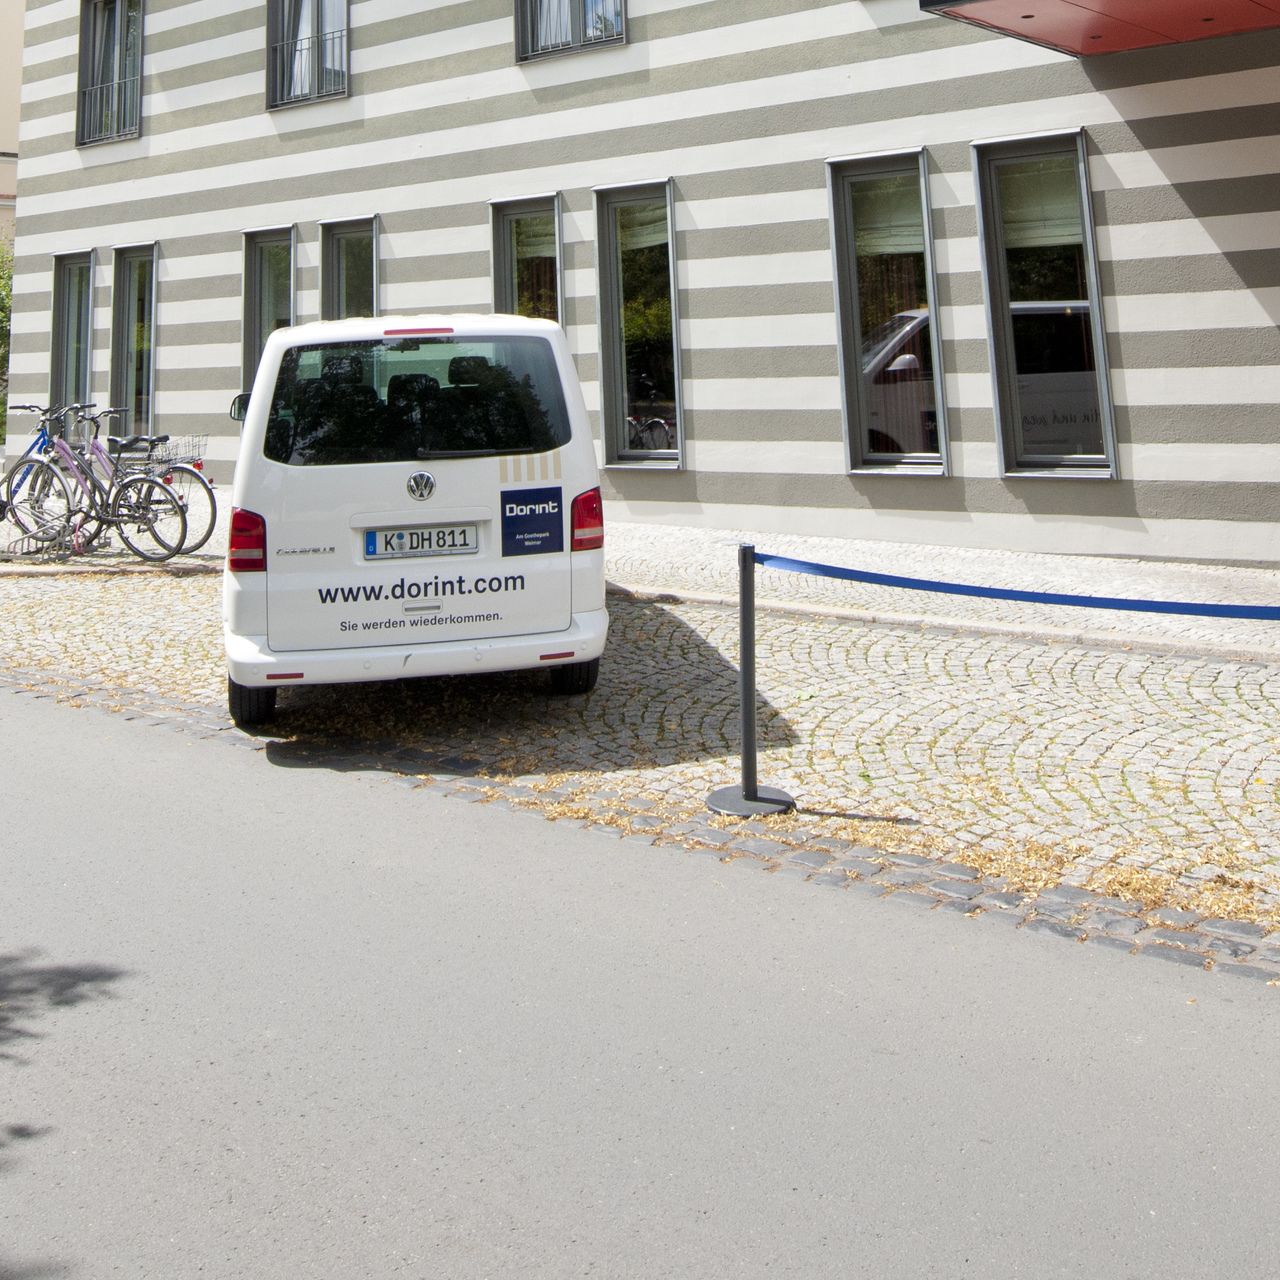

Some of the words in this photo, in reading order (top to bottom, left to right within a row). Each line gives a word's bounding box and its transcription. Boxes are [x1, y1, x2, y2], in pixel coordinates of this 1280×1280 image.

[505, 501, 559, 517] Dorint
[384, 533, 395, 552] K
[408, 531, 432, 550] DH
[436, 529, 469, 548] 811
[318, 574, 525, 604] www.dorint.com
[340, 620, 358, 632] Sie
[362, 616, 406, 630] werden
[409, 611, 503, 627] wiederkommen.
